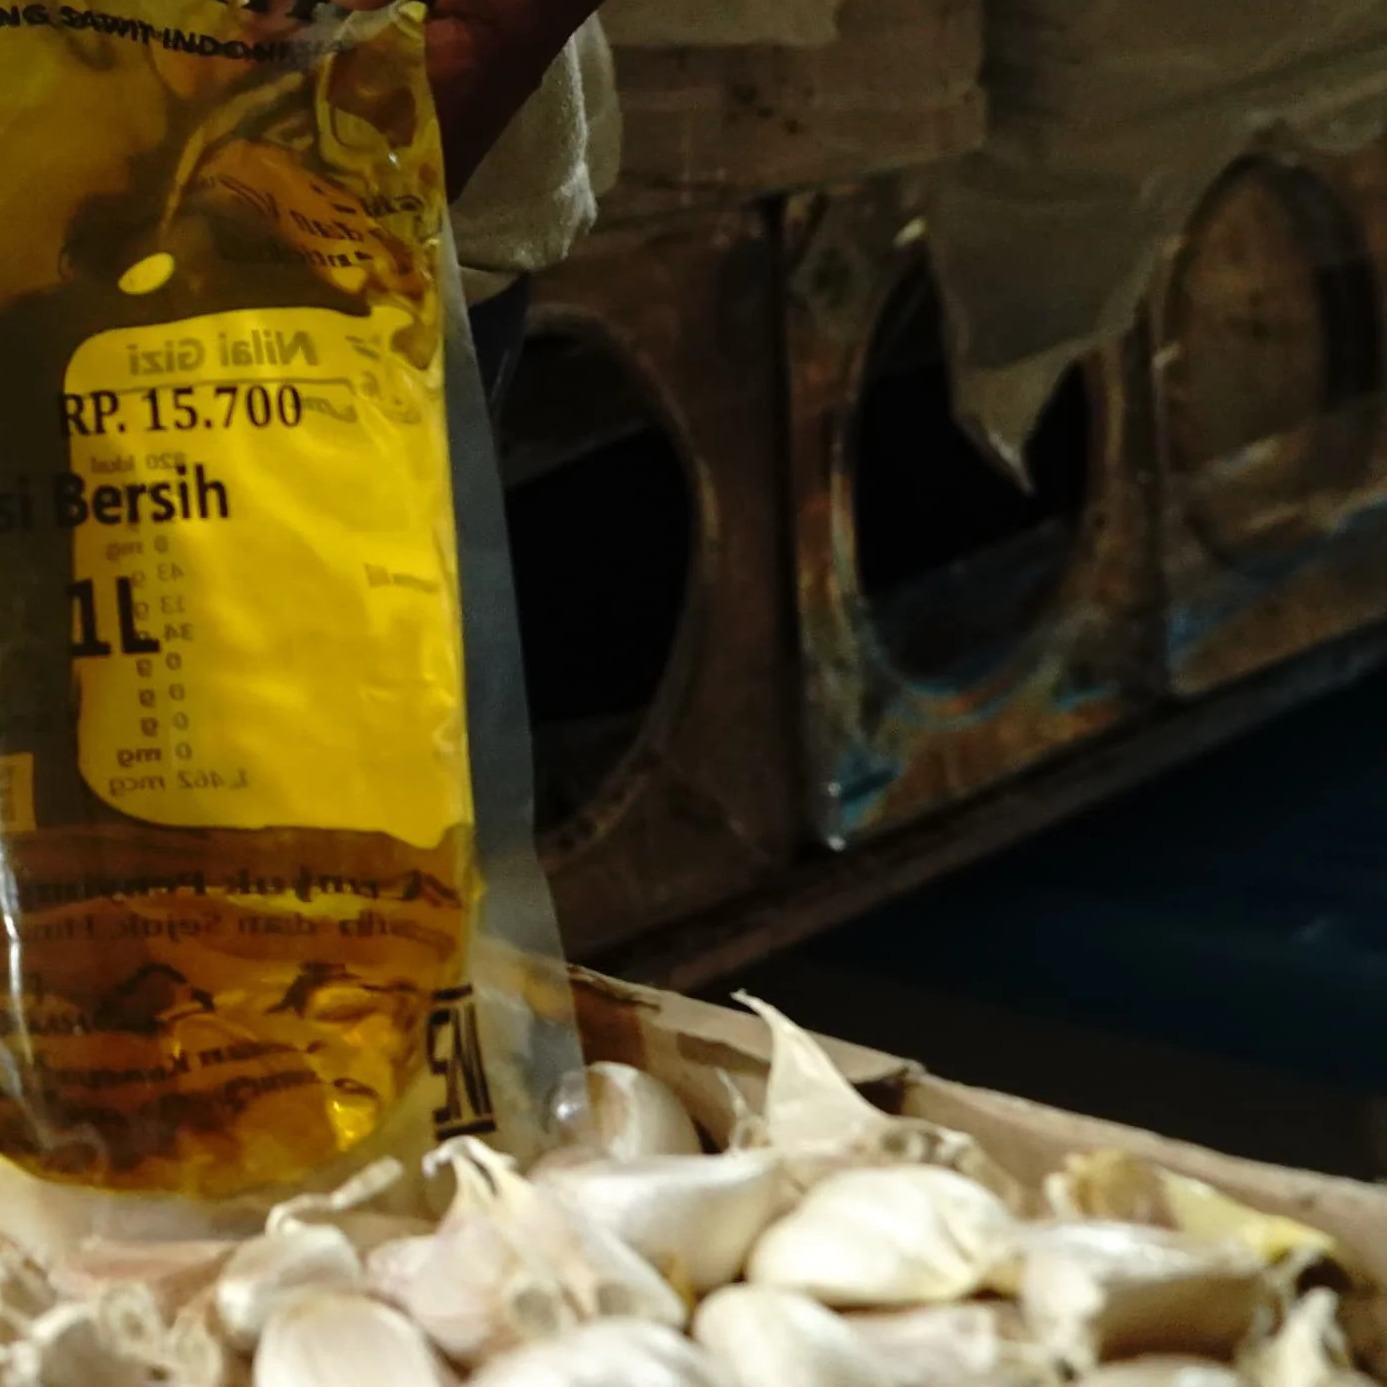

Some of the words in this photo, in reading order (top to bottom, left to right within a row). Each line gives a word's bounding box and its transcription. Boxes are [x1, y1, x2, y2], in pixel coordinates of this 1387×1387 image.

[57, 389, 126, 437] RP.
[144, 384, 304, 432] 15.700
[54, 463, 230, 528] Bersih
[65, 575, 161, 656] 1L
